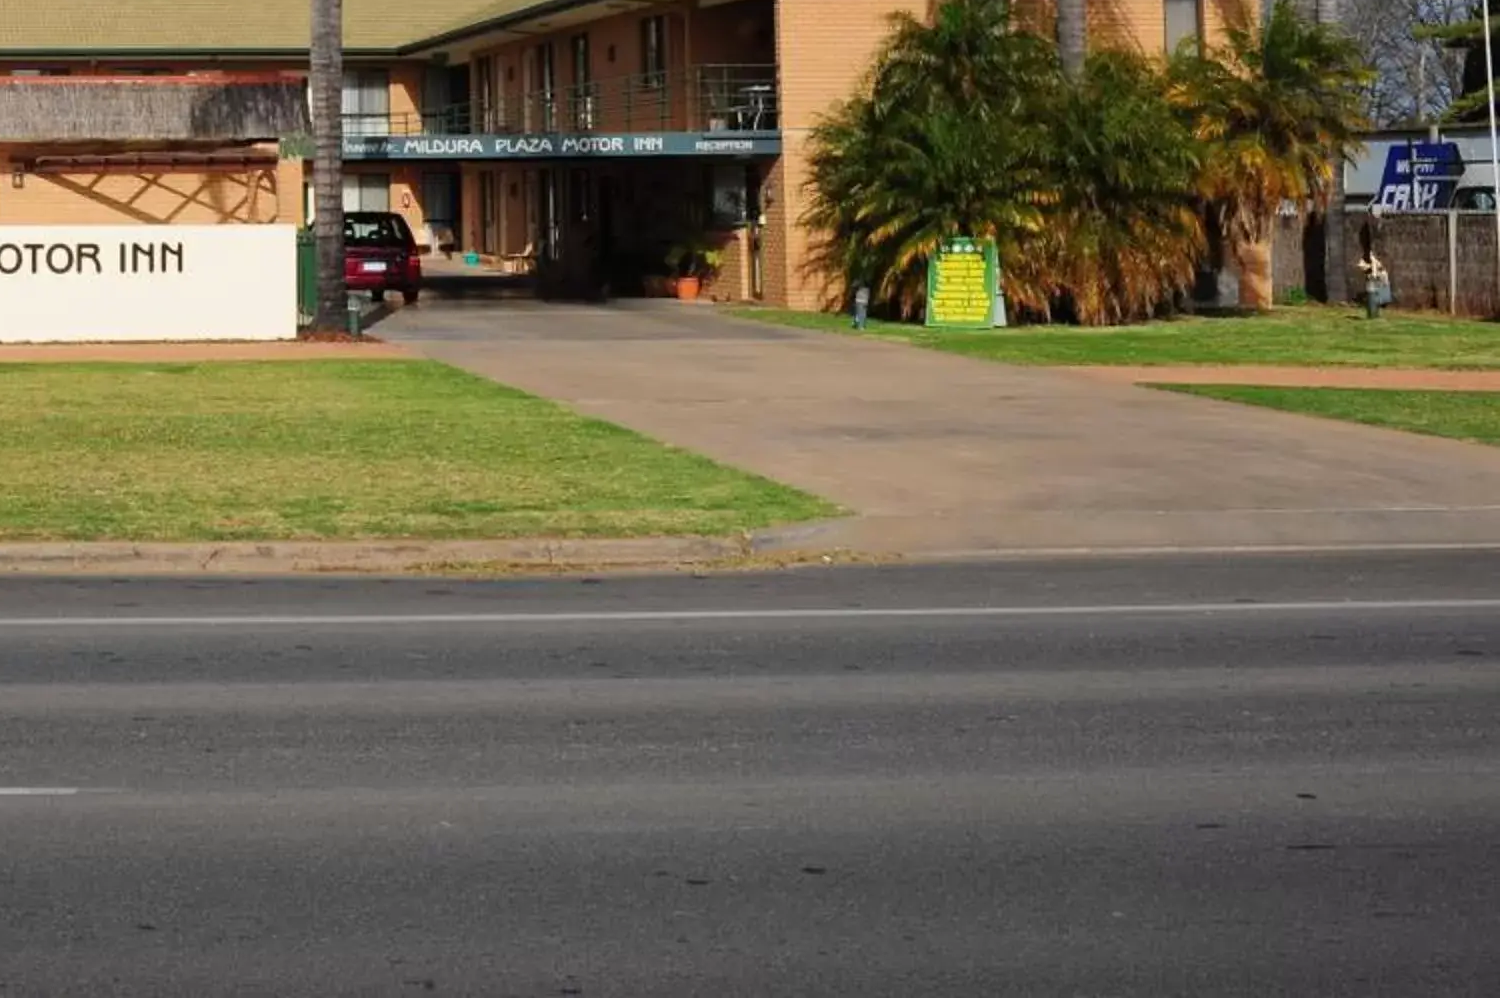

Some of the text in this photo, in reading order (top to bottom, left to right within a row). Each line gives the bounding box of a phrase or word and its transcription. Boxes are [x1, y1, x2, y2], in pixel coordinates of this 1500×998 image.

[403, 138, 483, 154] MILDURA
[495, 138, 553, 153] PLAZA
[561, 137, 624, 152] MOTOR
[634, 137, 663, 151] INN
[119, 242, 183, 274] INN
